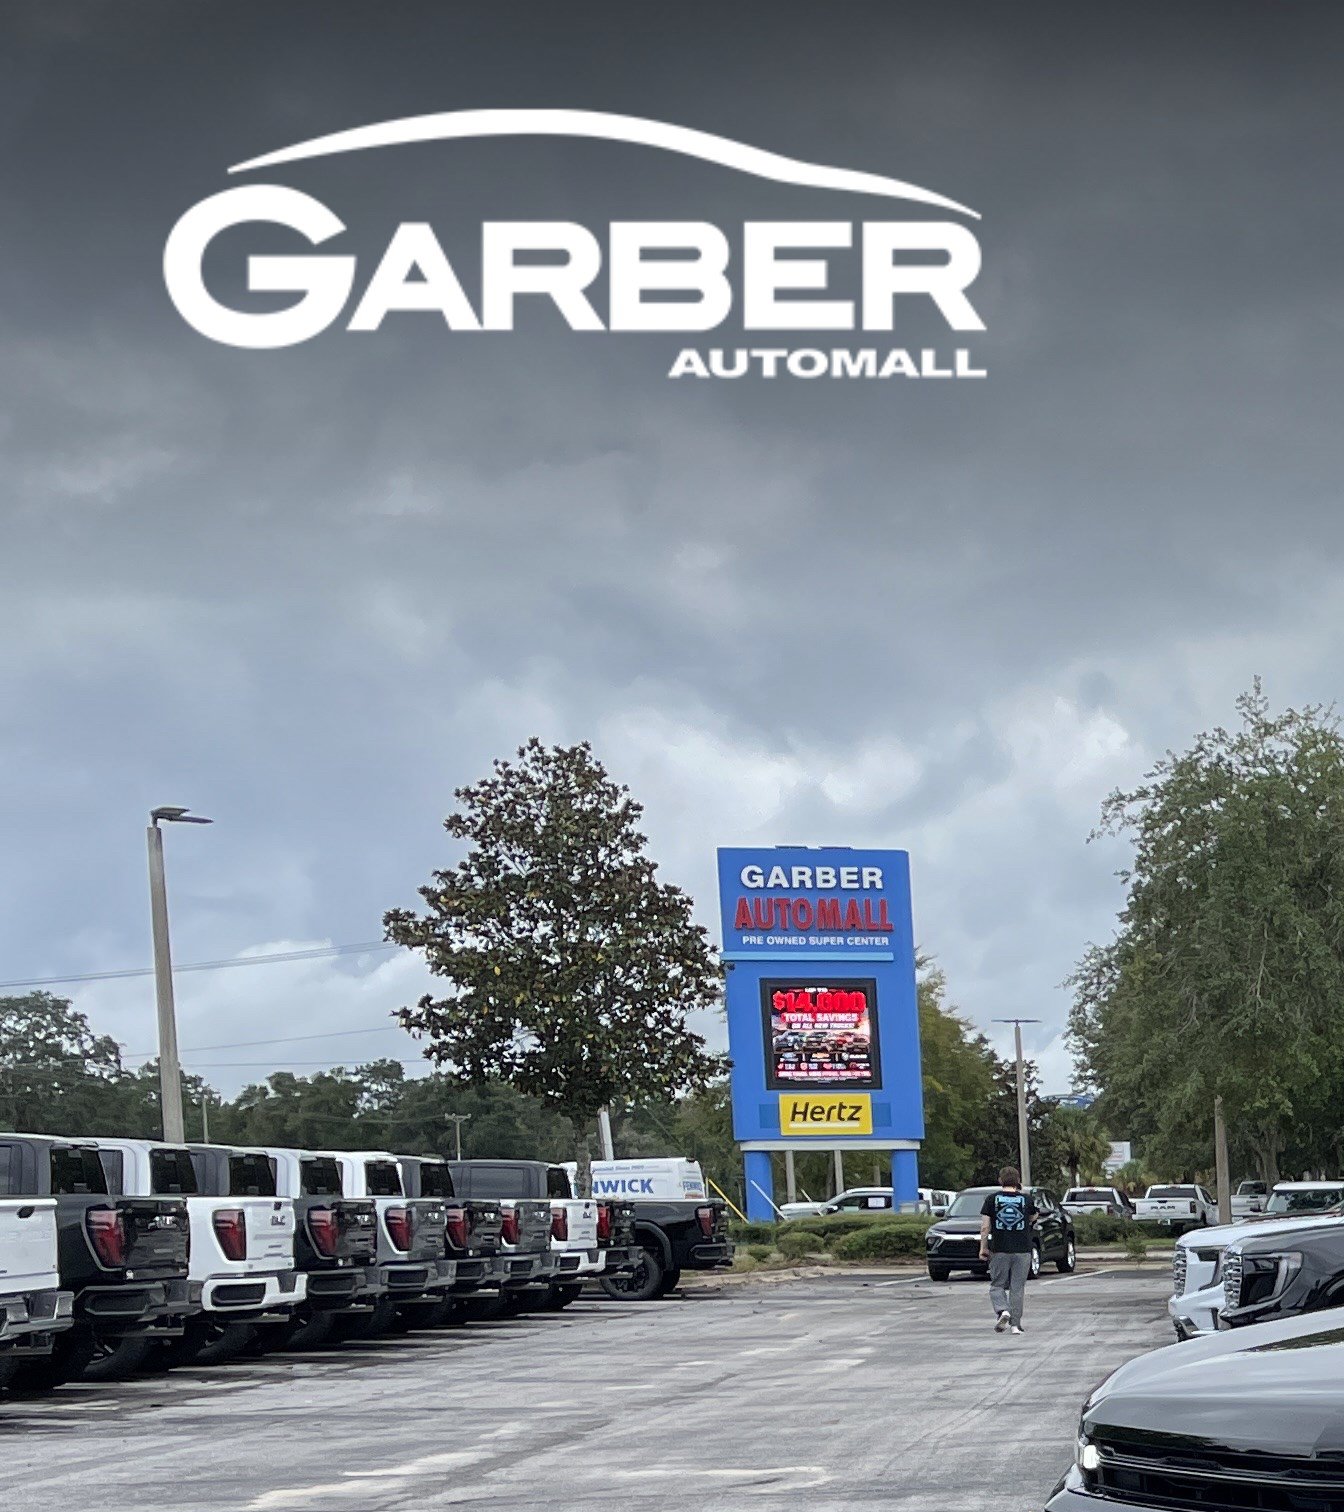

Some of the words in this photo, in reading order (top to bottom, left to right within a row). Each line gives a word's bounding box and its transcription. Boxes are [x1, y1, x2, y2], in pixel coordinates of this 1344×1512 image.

[740, 865, 883, 889] GARBER
[734, 896, 893, 932] AUTOMALL
[742, 935, 763, 945] PRE
[766, 936, 806, 945] OWNED
[808, 936, 844, 945] SUPER
[846, 936, 889, 946] CENTER
[785, 1013, 814, 1022] TOTAL
[816, 1013, 859, 1022] SAVINGS
[791, 1102, 862, 1121] Hertz
